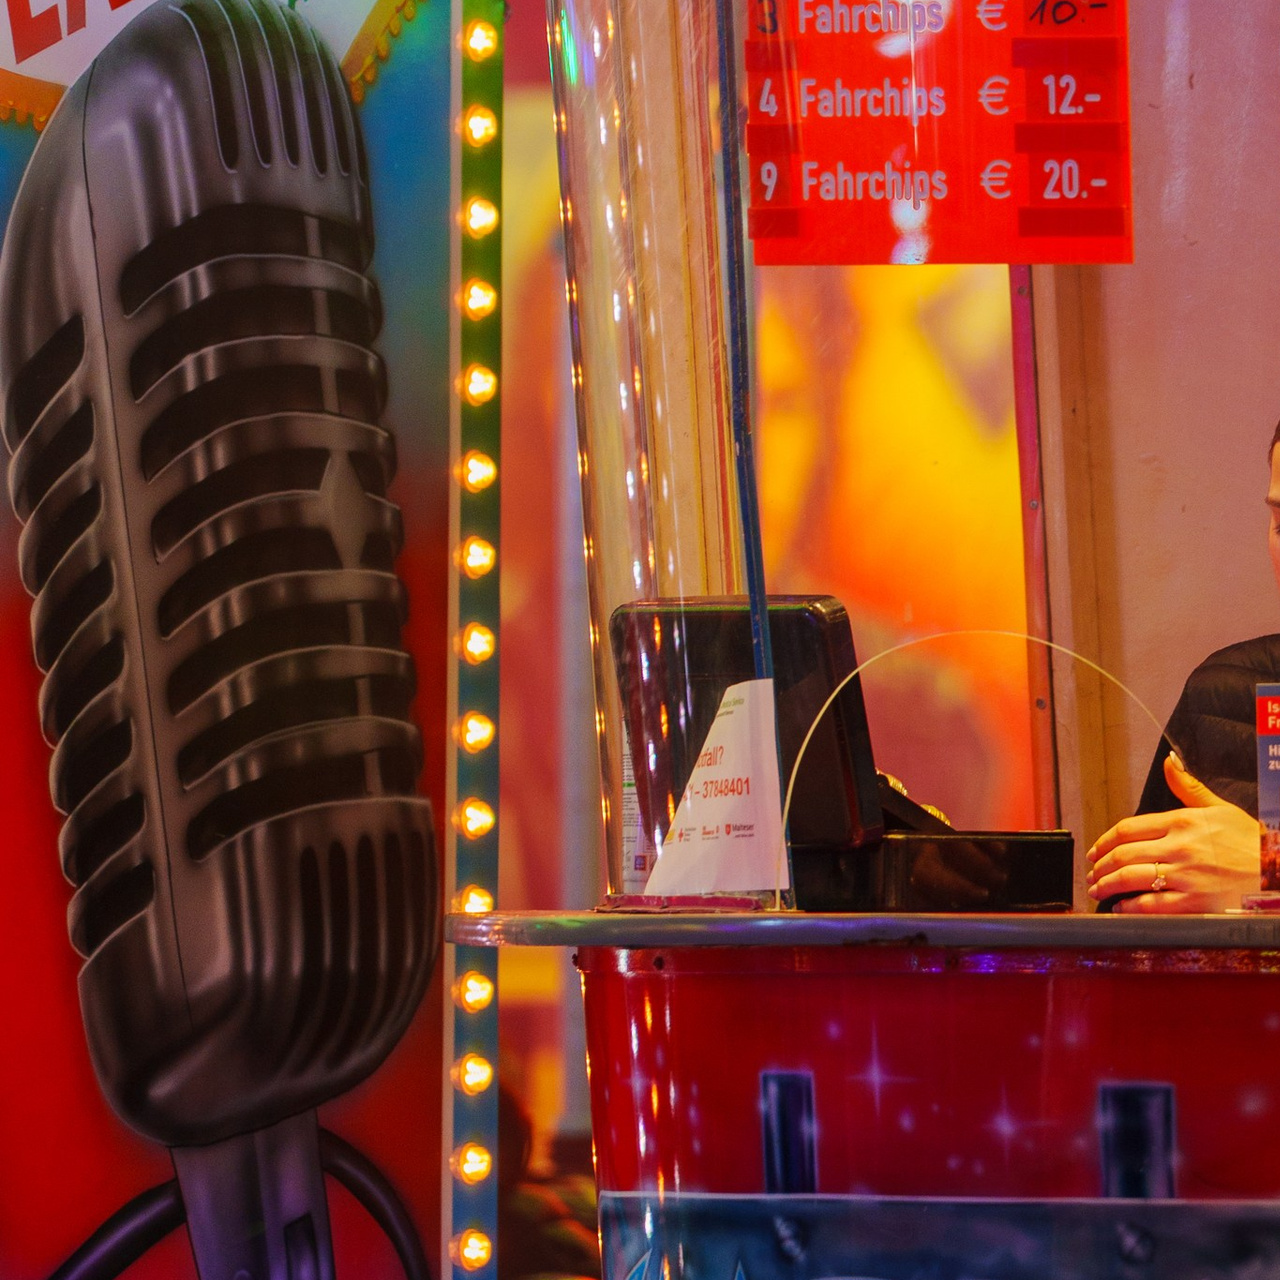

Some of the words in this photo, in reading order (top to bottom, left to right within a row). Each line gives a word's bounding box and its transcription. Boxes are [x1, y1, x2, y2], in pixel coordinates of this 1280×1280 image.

[759, 77, 779, 117] 4
[799, 77, 947, 127] Fahrchips
[978, 75, 1010, 116] €
[1043, 74, 1101, 115] 12.-
[760, 161, 778, 201] 9
[801, 161, 948, 210] Fahrchips
[980, 159, 1012, 200] €
[1043, 159, 1107, 200] 20.-
